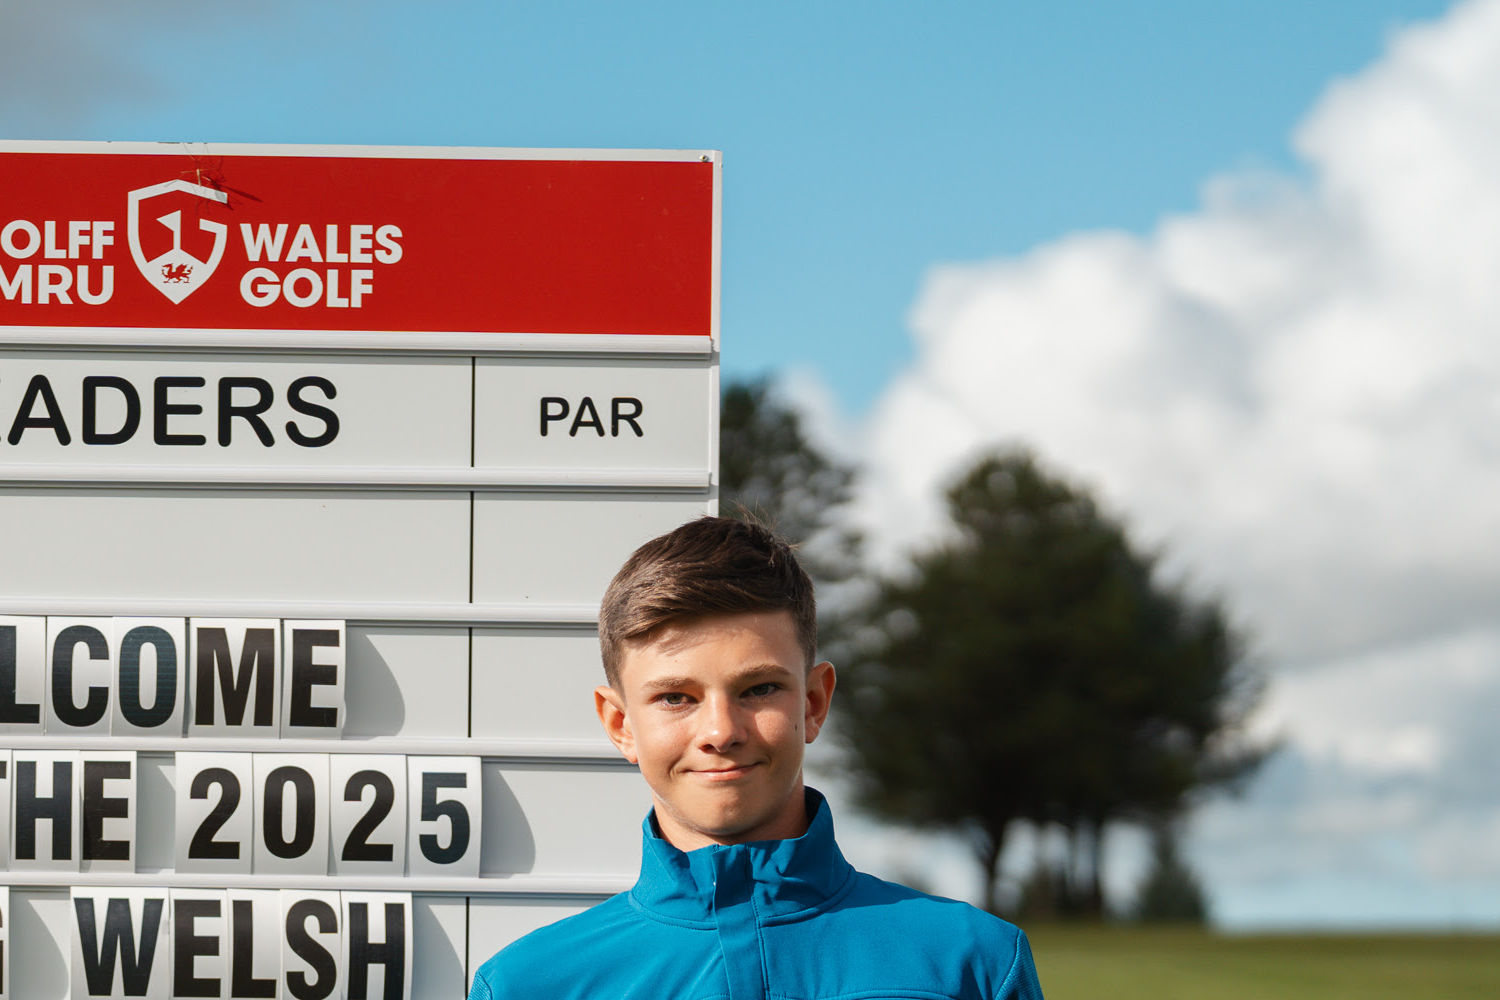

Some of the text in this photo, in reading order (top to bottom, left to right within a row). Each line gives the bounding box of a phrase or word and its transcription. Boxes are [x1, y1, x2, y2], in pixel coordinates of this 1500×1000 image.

[239, 223, 403, 265] WALES
[239, 267, 374, 308] GOLF
[540, 396, 644, 438] PAR
[188, 765, 472, 865] 2025
